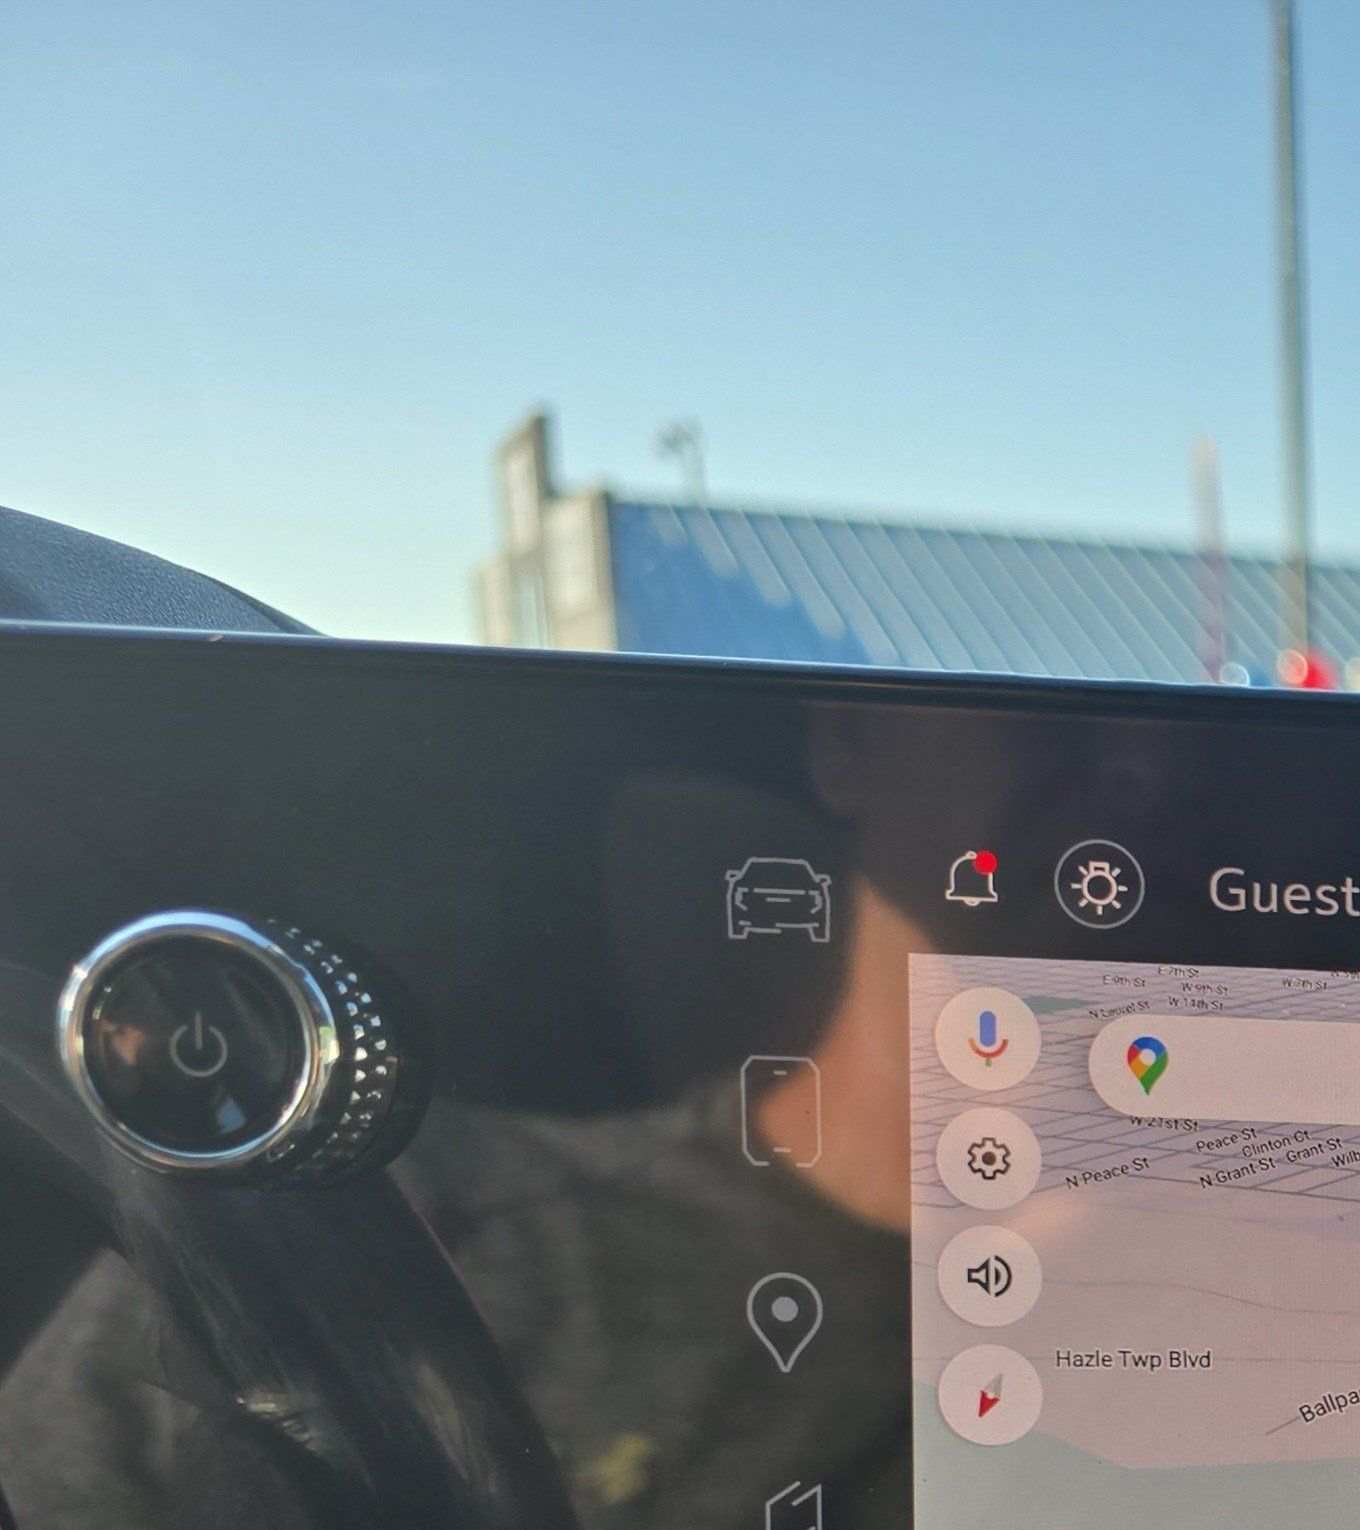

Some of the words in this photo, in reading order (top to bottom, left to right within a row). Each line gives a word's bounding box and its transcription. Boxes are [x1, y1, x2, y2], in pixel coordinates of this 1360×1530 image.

[1209, 867, 1360, 917] Guest
[1196, 1132, 1239, 1152] Peace
[1241, 1127, 1257, 1140] St
[1242, 1137, 1291, 1159] Clinton
[1294, 1130, 1310, 1142] Ct
[1286, 1144, 1324, 1164] Grant
[1326, 1137, 1344, 1151] St
[1065, 1176, 1078, 1189] N
[1082, 1163, 1130, 1185] Peace
[1132, 1157, 1150, 1171] St
[1200, 1175, 1213, 1189] N
[1215, 1163, 1255, 1183] Grant
[1258, 1157, 1276, 1171] St
[1056, 1350, 1113, 1368] Hazle
[1118, 1350, 1162, 1371] Twp
[1169, 1350, 1211, 1368] Blvd
